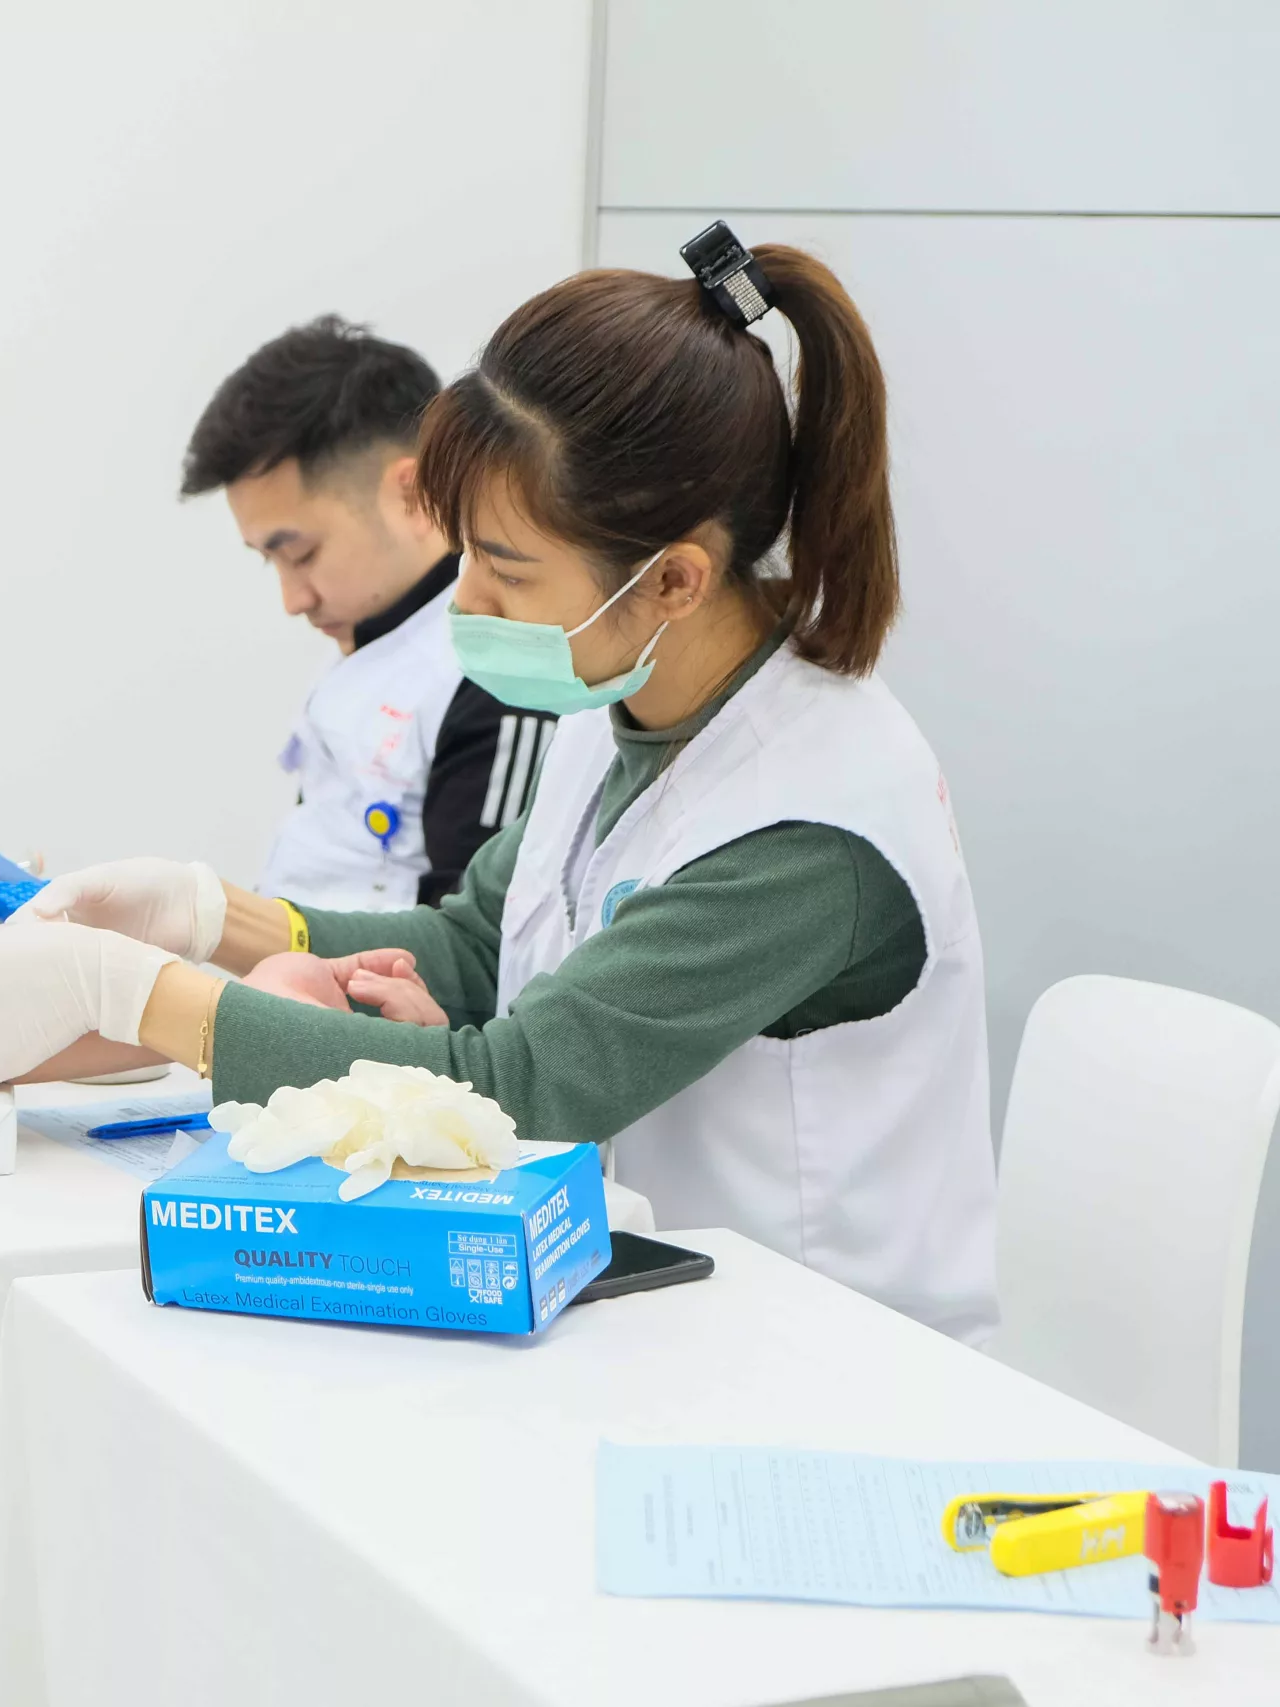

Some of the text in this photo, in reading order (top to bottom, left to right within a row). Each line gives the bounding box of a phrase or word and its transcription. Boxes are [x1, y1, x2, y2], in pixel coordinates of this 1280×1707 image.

[410, 1187, 515, 1205] MEDITEX
[151, 1200, 299, 1234] MEDITEX
[528, 1184, 570, 1242] MEDITEX
[458, 1243, 504, 1254] Single-Use
[532, 1216, 573, 1262] LATEX MEDICAL
[534, 1237, 571, 1280] EXAMINATION
[569, 1218, 591, 1246] GLOVES
[234, 1249, 411, 1277] QUALITY TOUCH
[235, 1273, 264, 1284] Premium
[387, 1286, 399, 1294] use
[399, 1285, 414, 1296] only
[483, 1289, 503, 1297] FOOD
[182, 1289, 488, 1326] Latex Medical Examination Gloves
[483, 1296, 503, 1305] SAFE
